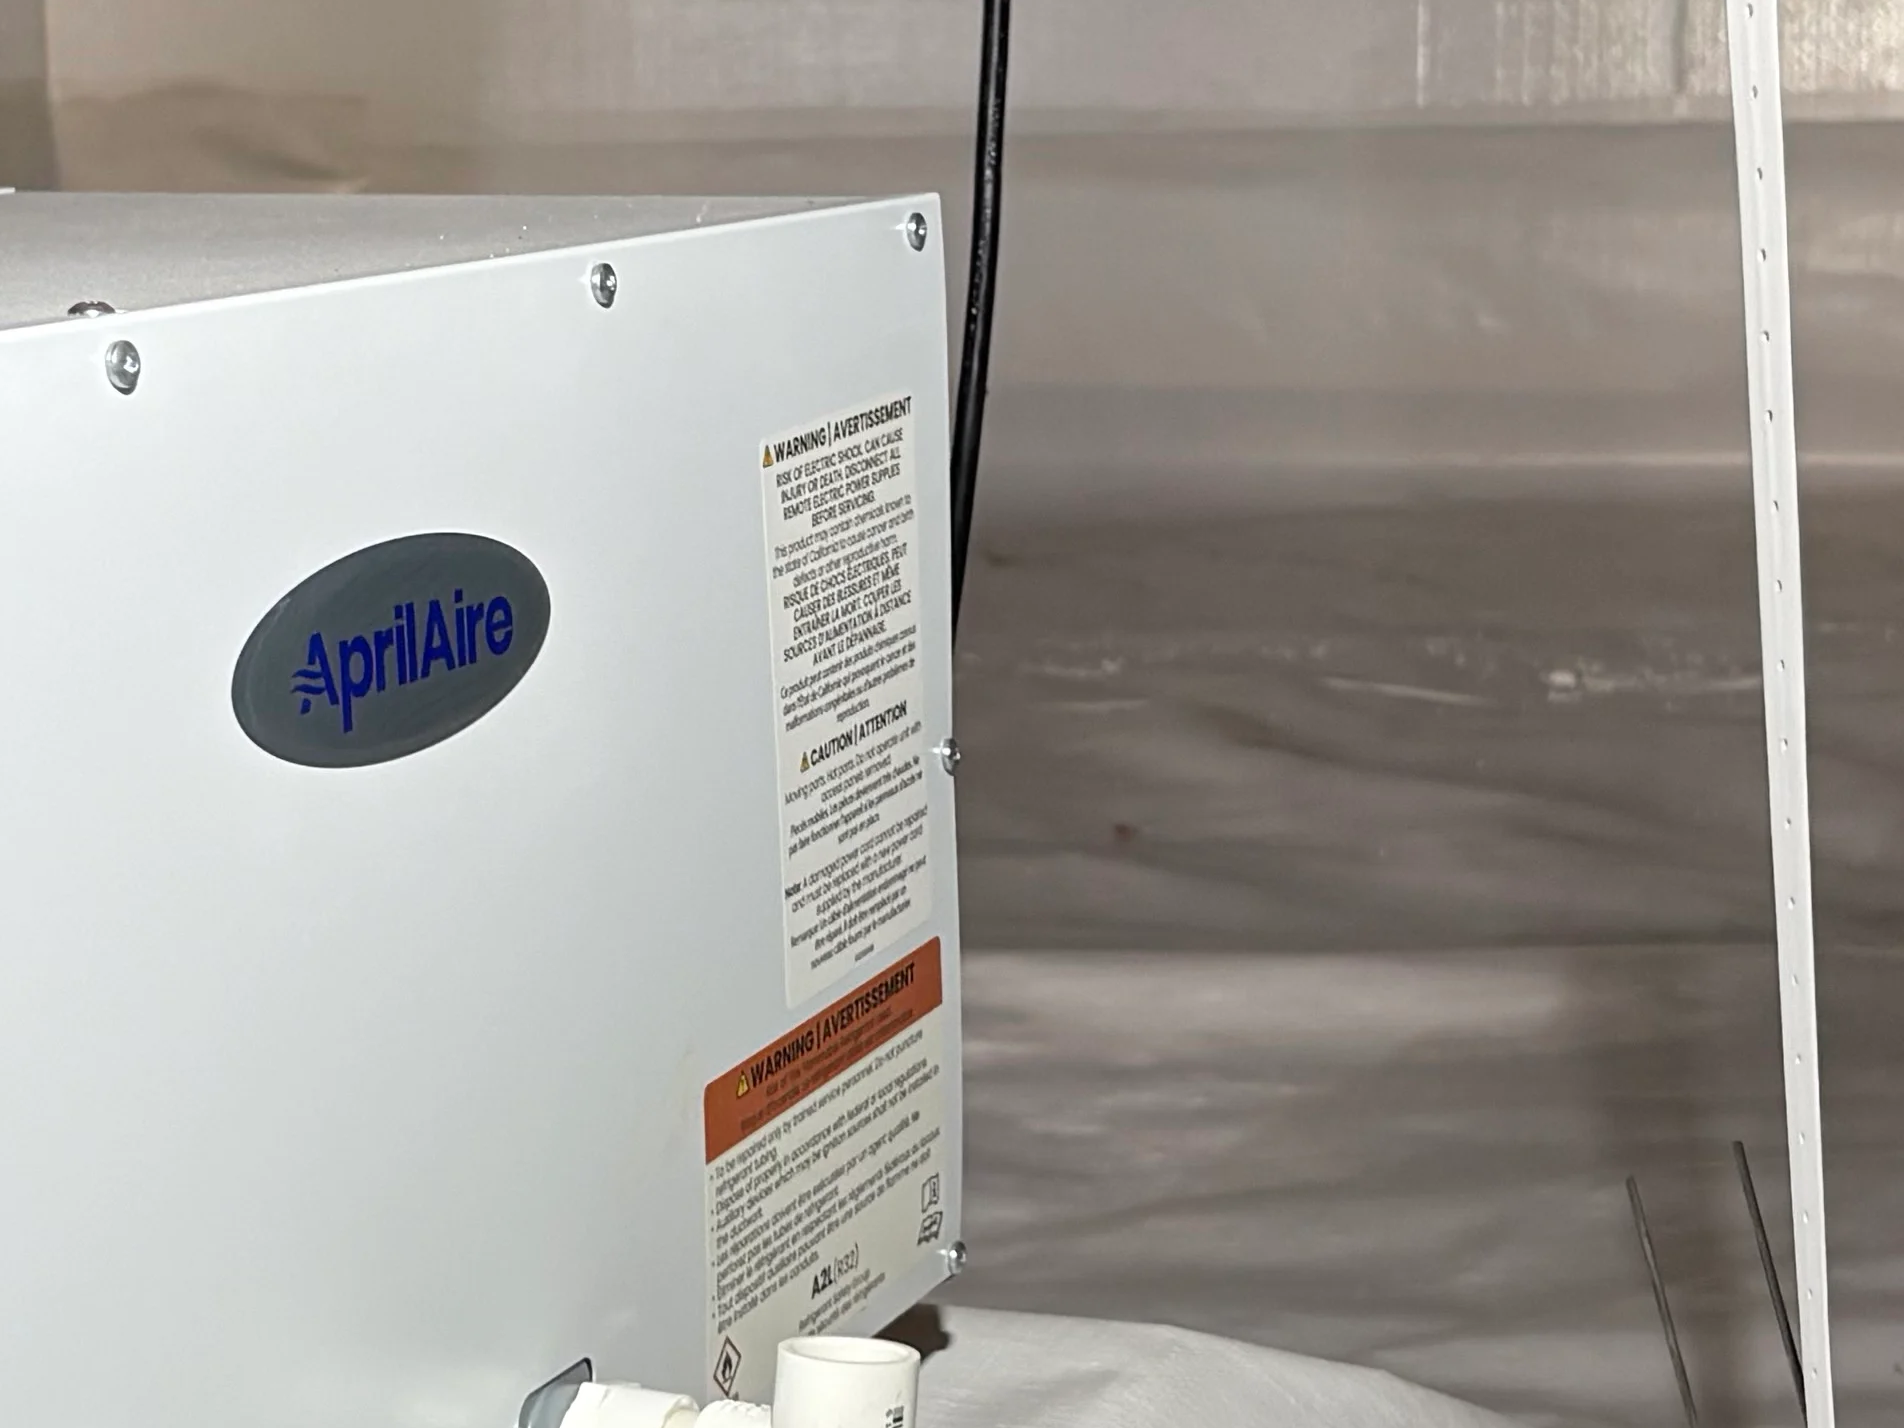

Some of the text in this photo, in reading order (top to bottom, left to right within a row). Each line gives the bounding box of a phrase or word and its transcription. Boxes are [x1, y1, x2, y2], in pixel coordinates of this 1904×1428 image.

[774, 396, 911, 462] WARNING AVERTISSEMENT
[290, 588, 514, 734] AprilAire
[810, 730, 853, 766] CAUTION
[859, 700, 907, 740] ATTENTION
[750, 1030, 814, 1088] WARNING
[823, 963, 915, 1041] AVERTISSEMENT
